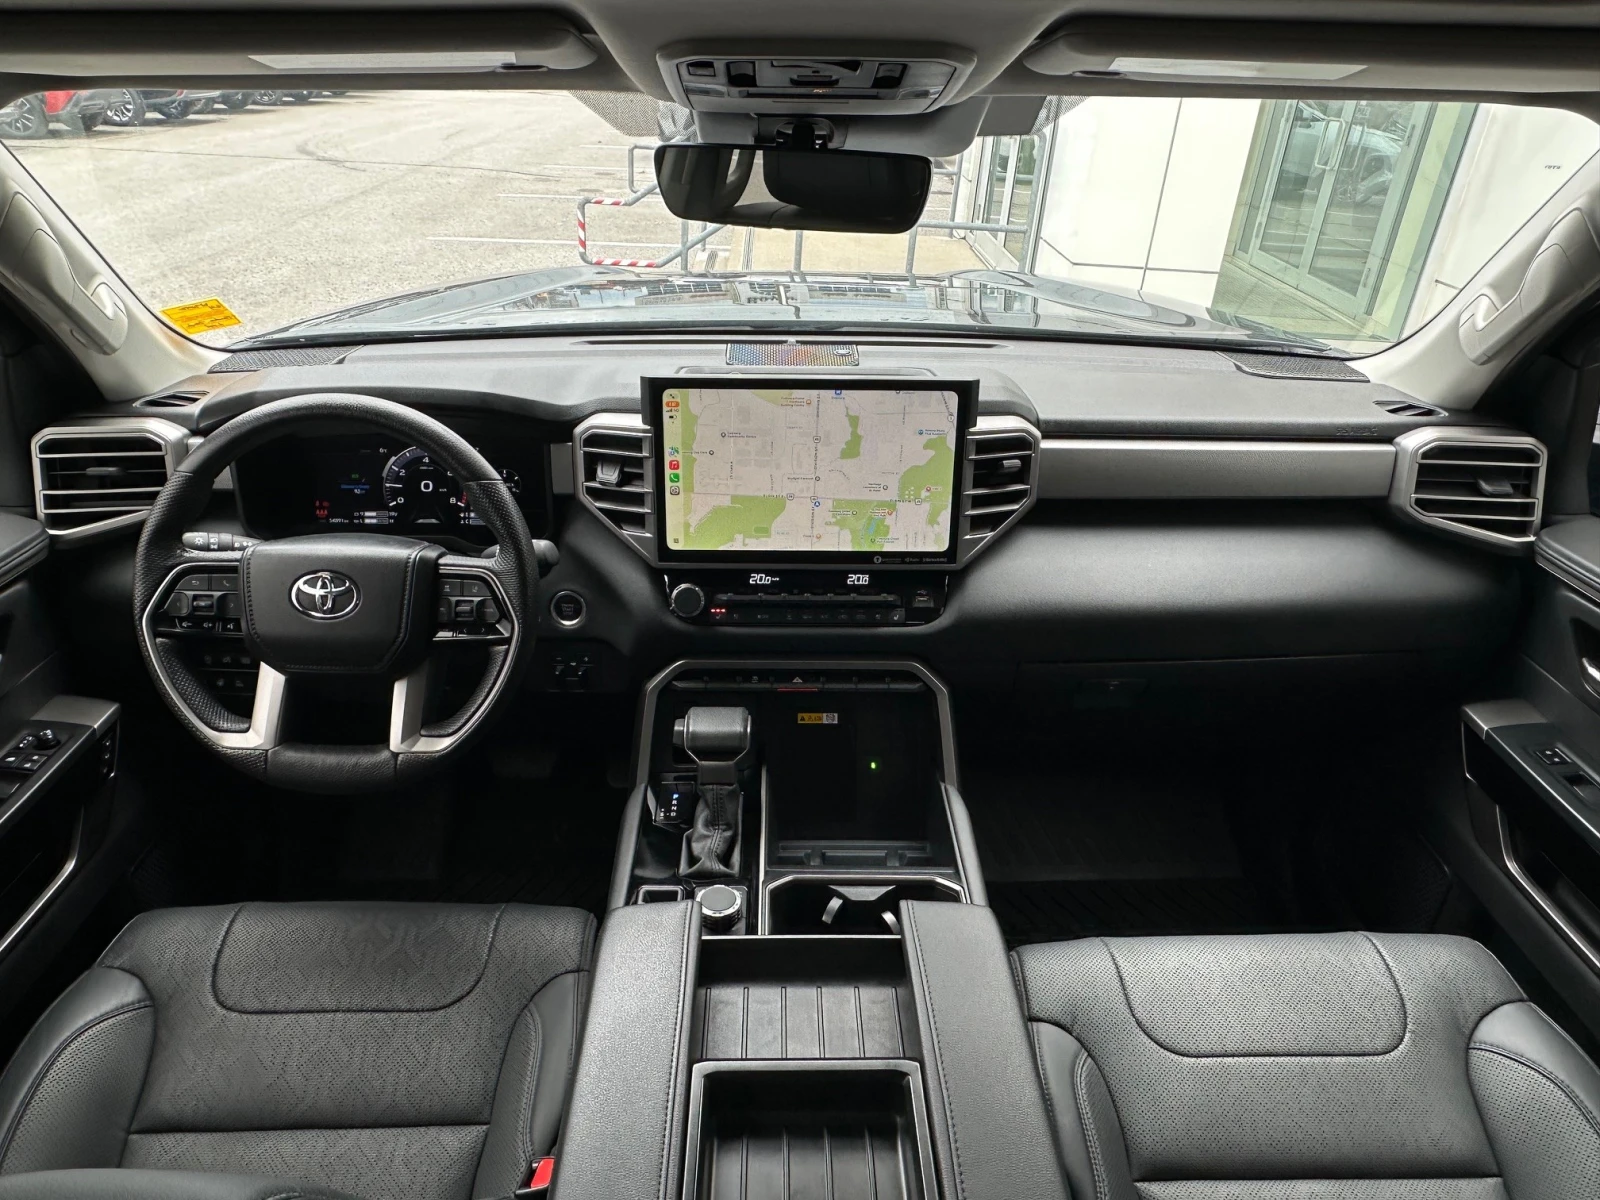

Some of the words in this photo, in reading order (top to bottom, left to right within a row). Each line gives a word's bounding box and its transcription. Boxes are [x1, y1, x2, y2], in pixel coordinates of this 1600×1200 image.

[420, 480, 433, 492] 0
[397, 496, 404, 504] 0
[449, 496, 457, 504] 8
[749, 573, 772, 584] 20.0
